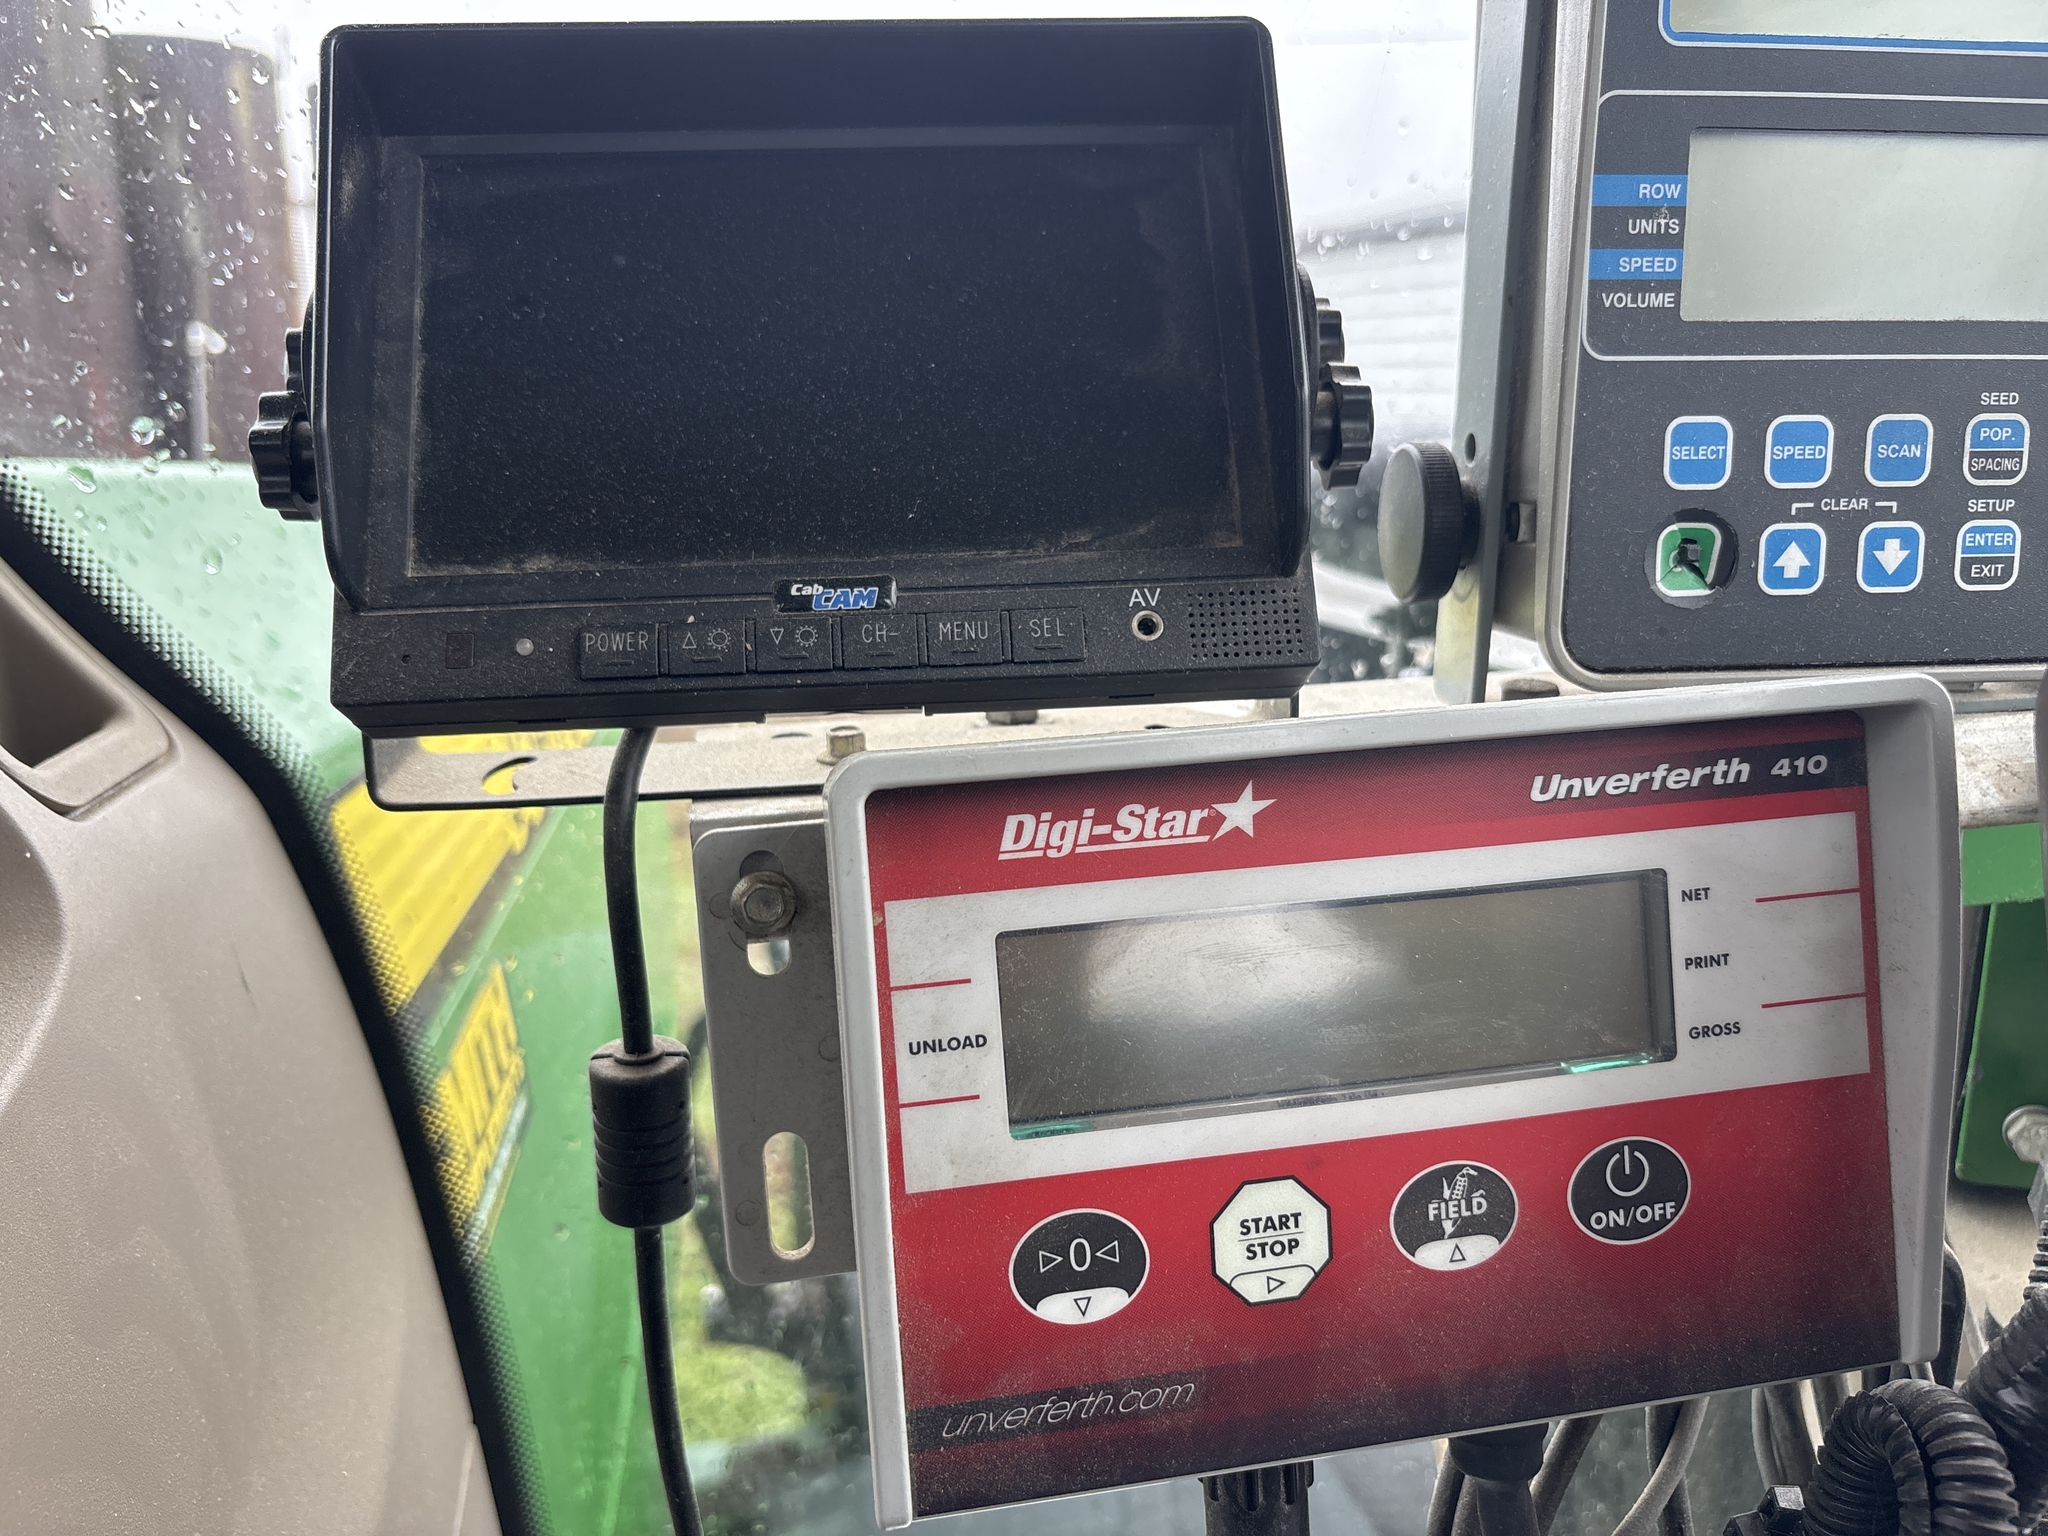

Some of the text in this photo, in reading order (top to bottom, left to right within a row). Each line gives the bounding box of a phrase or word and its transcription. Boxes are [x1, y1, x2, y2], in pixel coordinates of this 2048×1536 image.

[1638, 184, 1681, 199] ROW
[1628, 219, 1680, 235] UNITS
[1618, 258, 1677, 273] SPEED
[1602, 293, 1675, 309] VOLUME
[1980, 392, 2019, 406] SEED
[1671, 446, 1725, 461] SELECT
[1772, 445, 1826, 460] SPEED
[1877, 444, 1921, 459] SCAN
[1970, 458, 2020, 473] SPACING
[1820, 498, 1869, 512] CLEAR
[1967, 499, 2015, 512] SETUP
[1965, 533, 2013, 547] ENTER
[1970, 564, 2005, 577] EXIT
[790, 583, 824, 596] Cab
[1129, 588, 1160, 607] AV
[812, 587, 879, 611] CAM
[938, 620, 989, 642] MENU
[1029, 616, 1066, 638] SEL
[585, 632, 650, 654] POWER
[1529, 754, 1828, 803] Unverferth 410
[1681, 887, 1710, 902] NET
[1684, 953, 1730, 970] PRINT
[1688, 1021, 1741, 1040] GROSS
[908, 1034, 988, 1056] UNLOAD
[1427, 1197, 1488, 1222] FIELD
[1589, 1201, 1677, 1230] ON/OFF
[1239, 1212, 1302, 1236] START
[1069, 1237, 1092, 1272] 0
[1245, 1238, 1300, 1260] STOP
[942, 1382, 1195, 1438] unverferth.com
